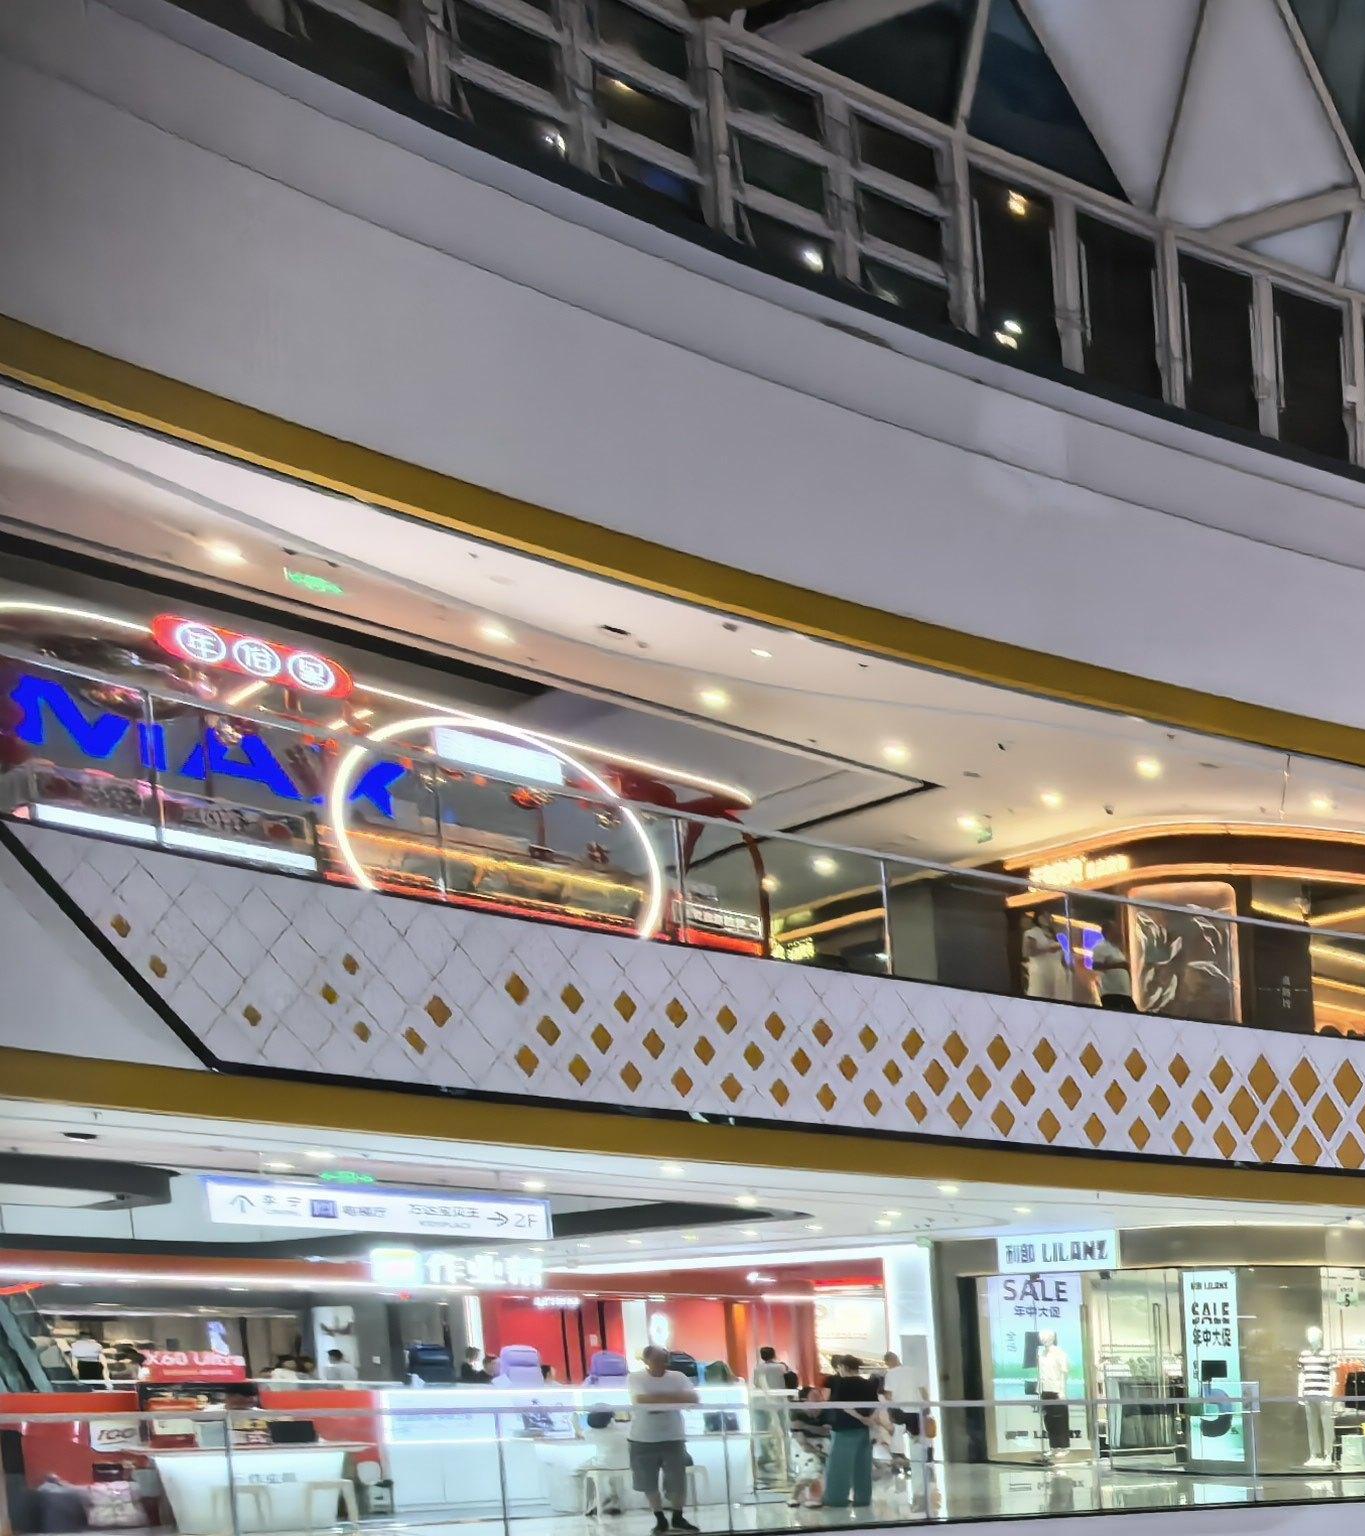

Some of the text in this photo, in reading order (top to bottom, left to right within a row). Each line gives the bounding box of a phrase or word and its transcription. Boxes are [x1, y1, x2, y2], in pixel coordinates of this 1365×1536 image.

[514, 1213, 539, 1229] 2F
[1041, 1239, 1108, 1263] LILANZ
[1002, 1278, 1069, 1302] SALE
